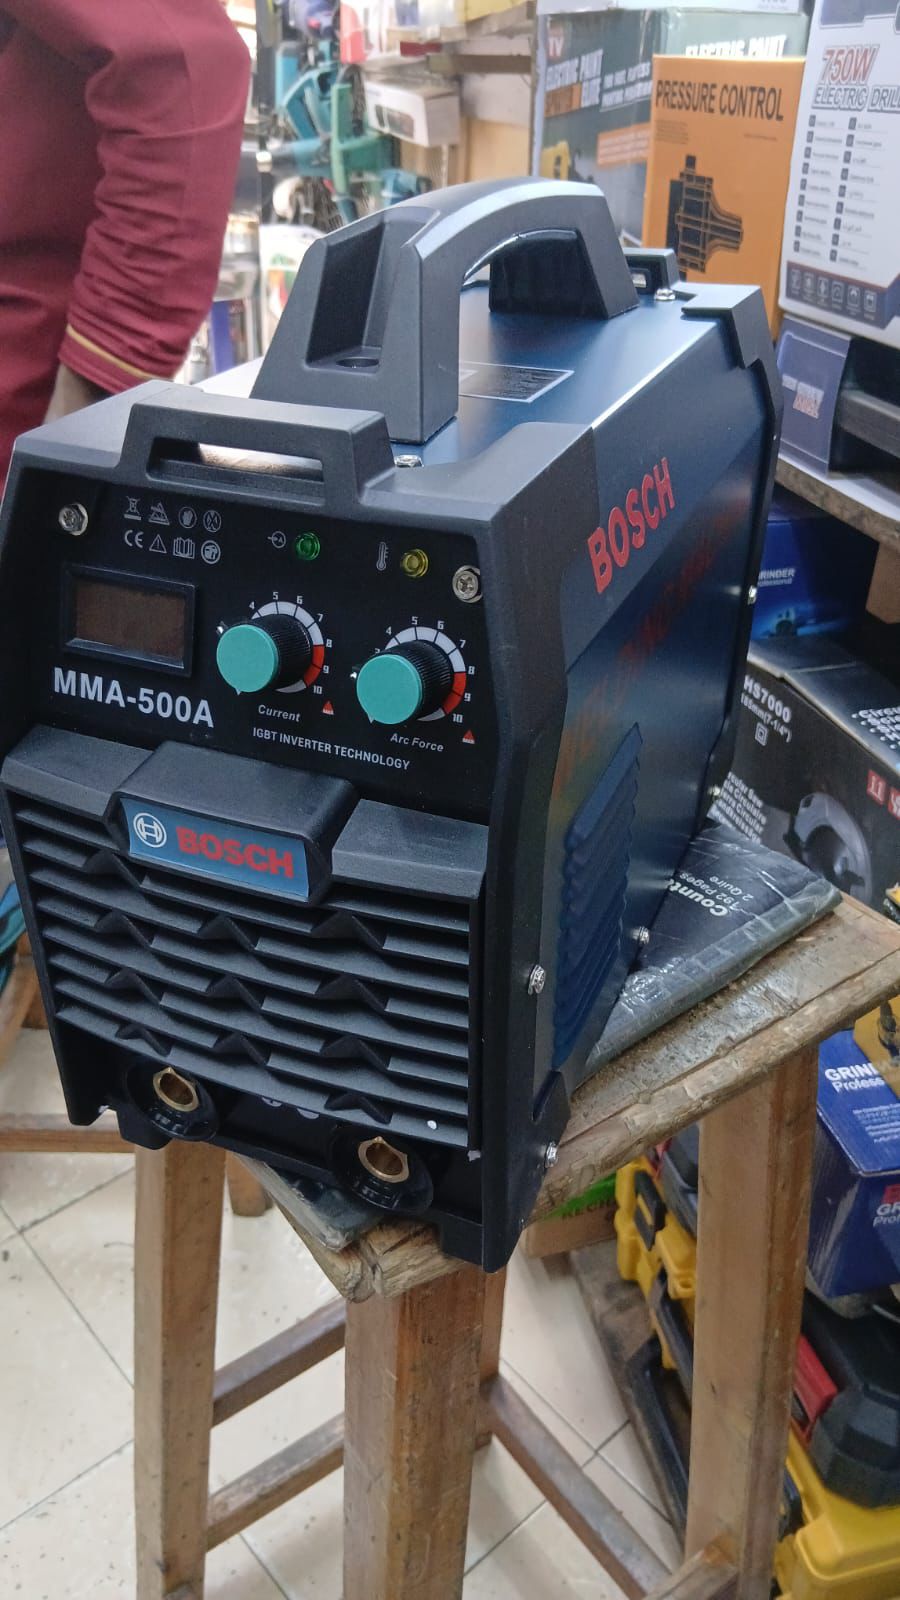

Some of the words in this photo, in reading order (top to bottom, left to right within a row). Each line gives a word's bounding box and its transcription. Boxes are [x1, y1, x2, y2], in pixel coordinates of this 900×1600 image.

[822, 44, 880, 85] 750W
[656, 80, 717, 114] PRESSURE
[719, 84, 784, 121] CONTROL
[813, 85, 867, 111] ELECTRIC
[587, 456, 676, 595] BOSCH
[272, 591, 279, 600] 5
[296, 596, 303, 605] 6
[249, 601, 255, 610] 4
[317, 613, 324, 622] 7
[411, 616, 418, 625] 5
[437, 620, 445, 630] 6
[385, 626, 392, 635] 4
[325, 638, 333, 648] 8
[459, 639, 466, 649] 7
[323, 664, 330, 674] 9
[468, 665, 475, 675] 8
[313, 685, 323, 695] 10
[53, 666, 214, 729] MMA-500A
[464, 692, 471, 702] 9
[743, 674, 791, 723] HS7000
[258, 704, 301, 723] Current
[452, 713, 463, 723] 10
[390, 733, 409, 745] Arc
[412, 737, 444, 752] Force
[253, 726, 278, 741] IGBT
[279, 733, 332, 754] INVERTER
[334, 744, 411, 770] TECHNOLOGY
[176, 826, 294, 879] BOSCH
[680, 872, 718, 896] Pages
[709, 875, 743, 896] Quire
